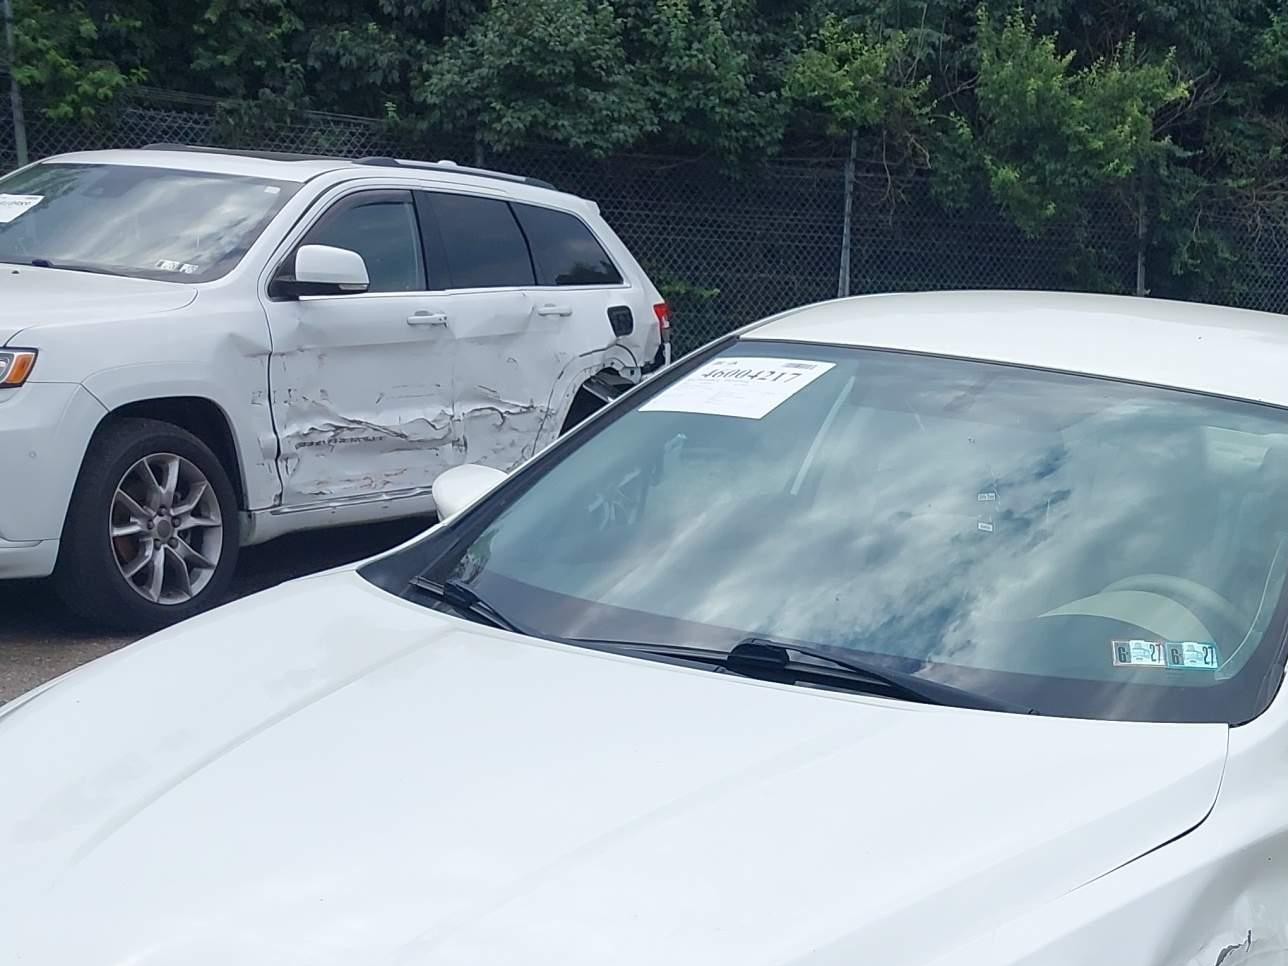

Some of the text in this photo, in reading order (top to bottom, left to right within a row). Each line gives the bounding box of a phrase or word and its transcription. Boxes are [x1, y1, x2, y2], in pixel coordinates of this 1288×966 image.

[701, 368, 802, 384] 46004217
[1118, 644, 1161, 664] 6 27
[1171, 646, 1215, 666] 6 27
